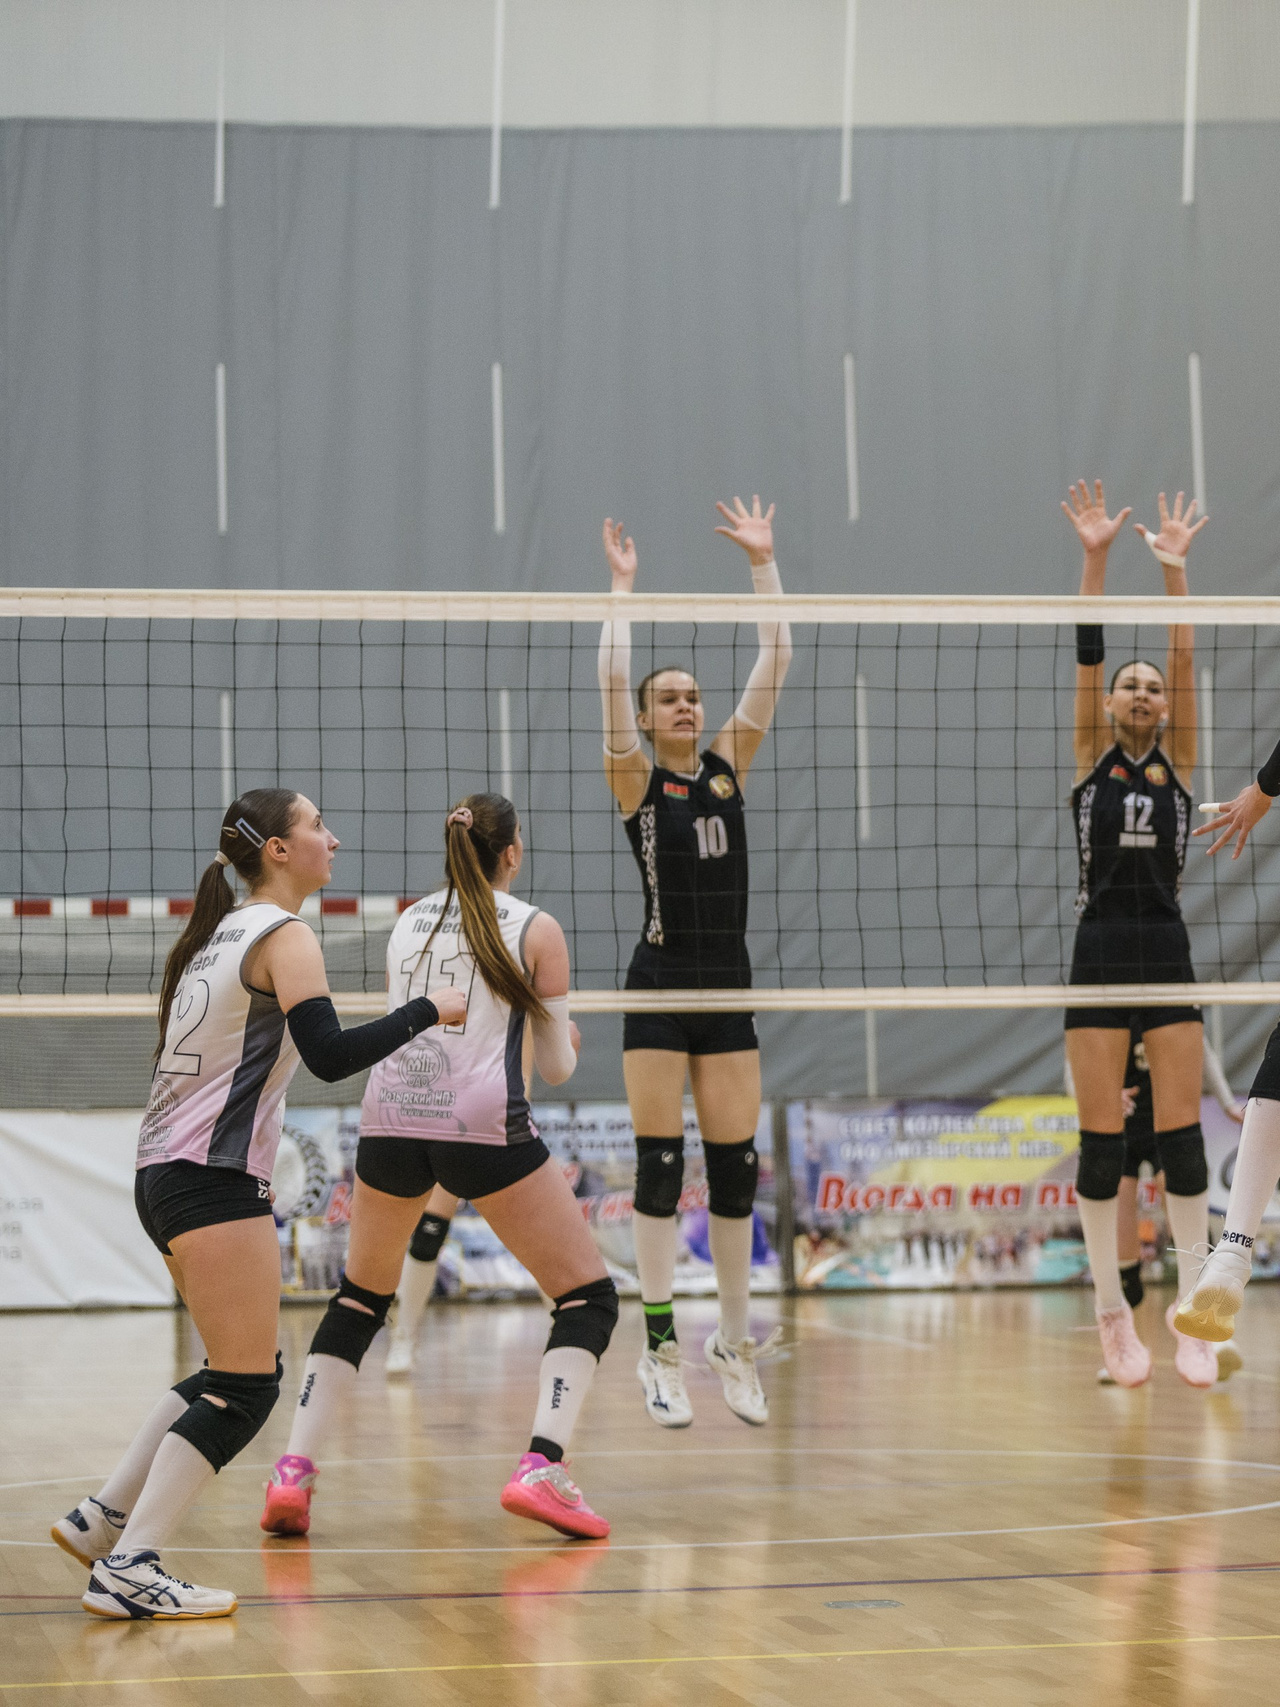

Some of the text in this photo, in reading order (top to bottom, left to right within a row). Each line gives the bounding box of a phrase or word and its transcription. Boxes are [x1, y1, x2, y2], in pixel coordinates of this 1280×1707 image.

[1123, 791, 1155, 833] 12
[693, 815, 729, 860] 10
[378, 1087, 457, 1107] Мозырский НПЗ
[818, 1173, 956, 1211] Всегда
[968, 1183, 1022, 1208] на
